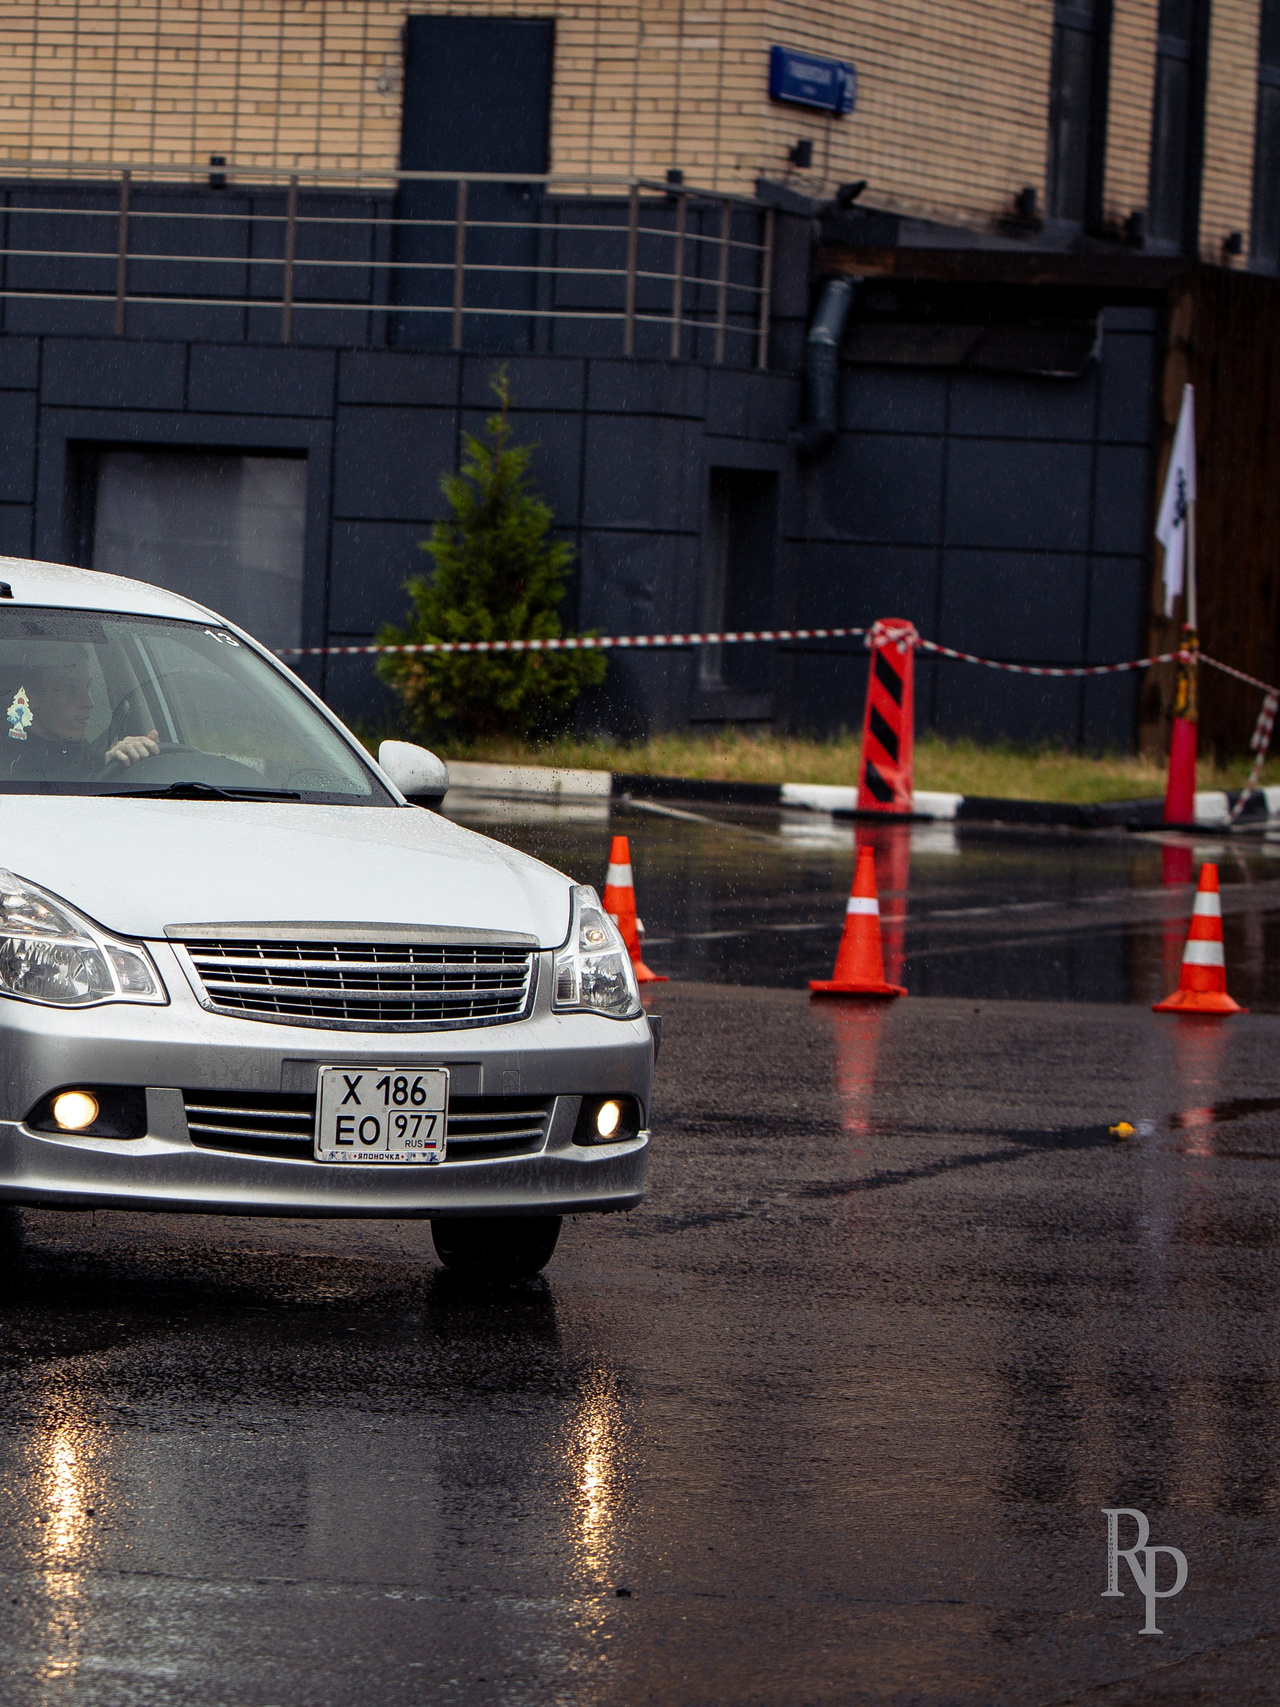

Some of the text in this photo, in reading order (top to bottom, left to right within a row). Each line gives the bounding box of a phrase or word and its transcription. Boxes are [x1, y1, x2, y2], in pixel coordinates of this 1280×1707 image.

[203, 629, 240, 647] 13
[375, 1075, 427, 1106] 186
[395, 1114, 438, 1138] 977
[404, 1139, 423, 1148] RUS
